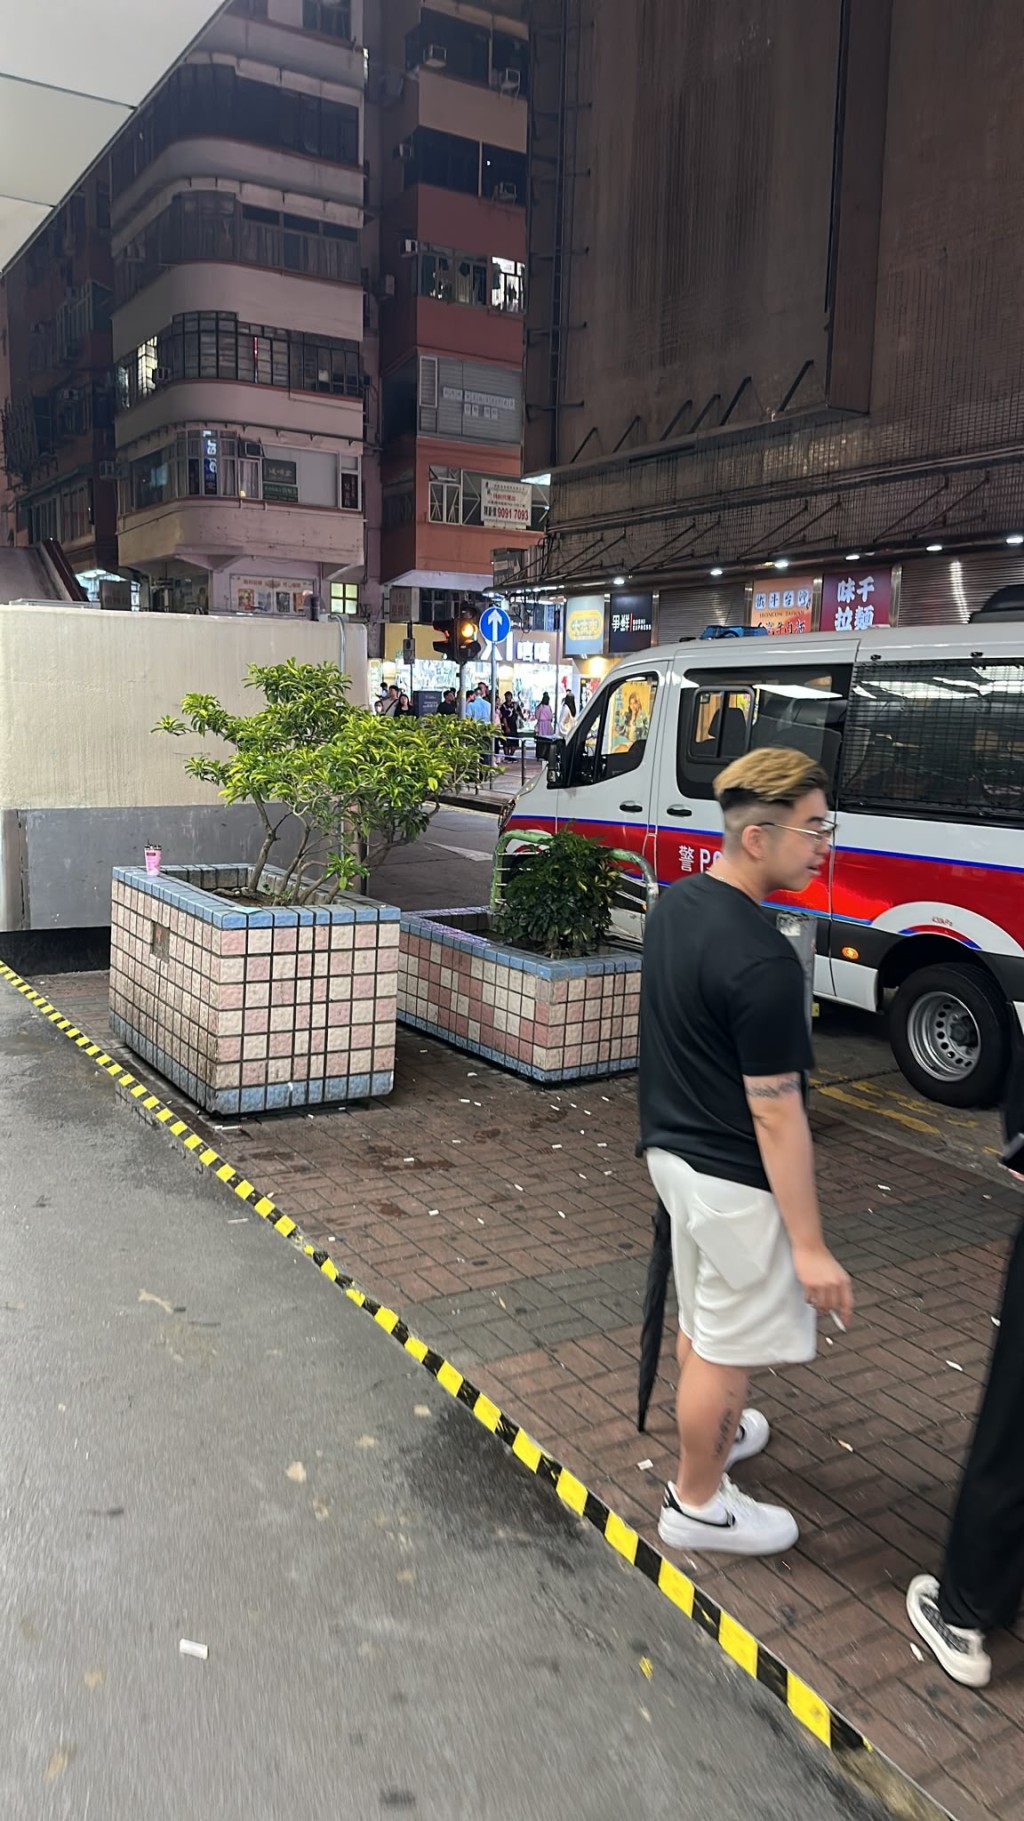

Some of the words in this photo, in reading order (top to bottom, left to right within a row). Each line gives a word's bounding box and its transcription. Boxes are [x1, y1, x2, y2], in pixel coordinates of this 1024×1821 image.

[514, 509, 529, 521] 7093
[837, 575, 875, 603] 味千
[834, 605, 875, 631] 拉麵
[679, 844, 695, 872] 警
